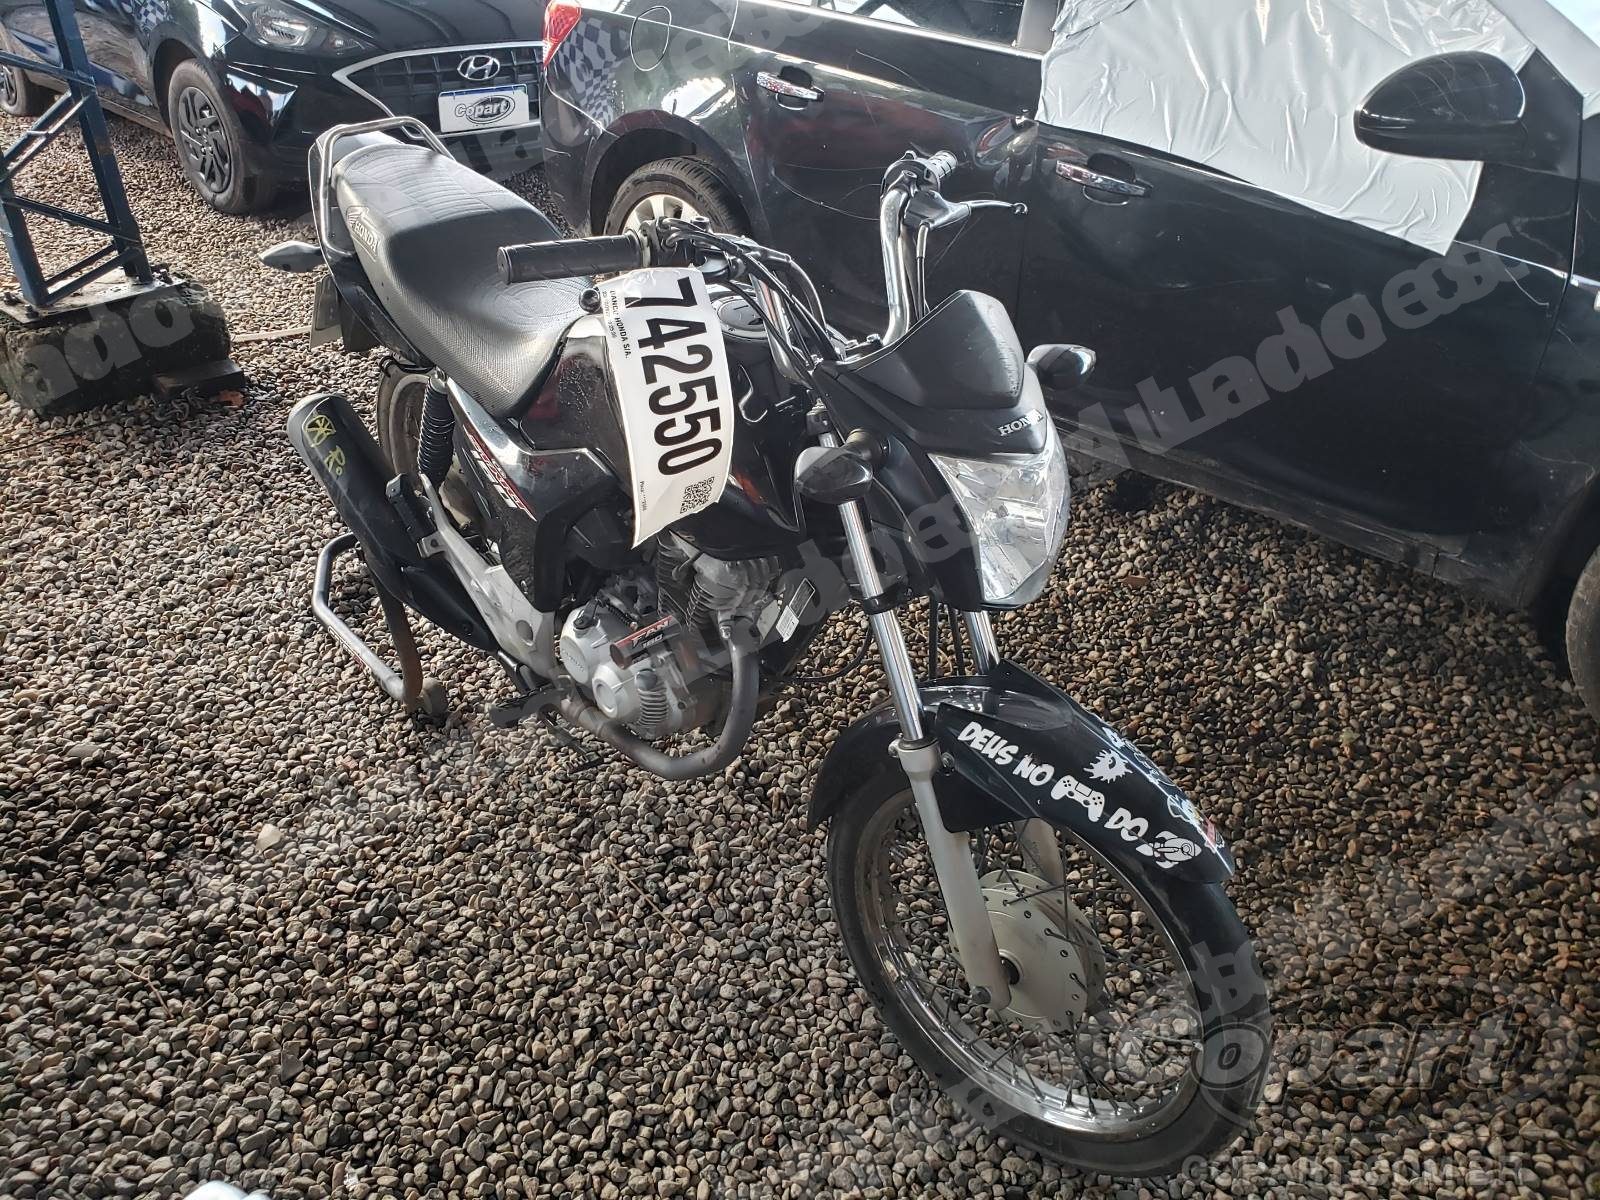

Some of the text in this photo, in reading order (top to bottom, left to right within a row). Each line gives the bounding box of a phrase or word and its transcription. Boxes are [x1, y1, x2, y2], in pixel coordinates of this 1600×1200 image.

[455, 99, 508, 119] Copart
[615, 317, 628, 342] HONDA
[624, 276, 722, 475] 742550
[997, 408, 1043, 437] HON
[957, 721, 1149, 842] DEUS NO DO
